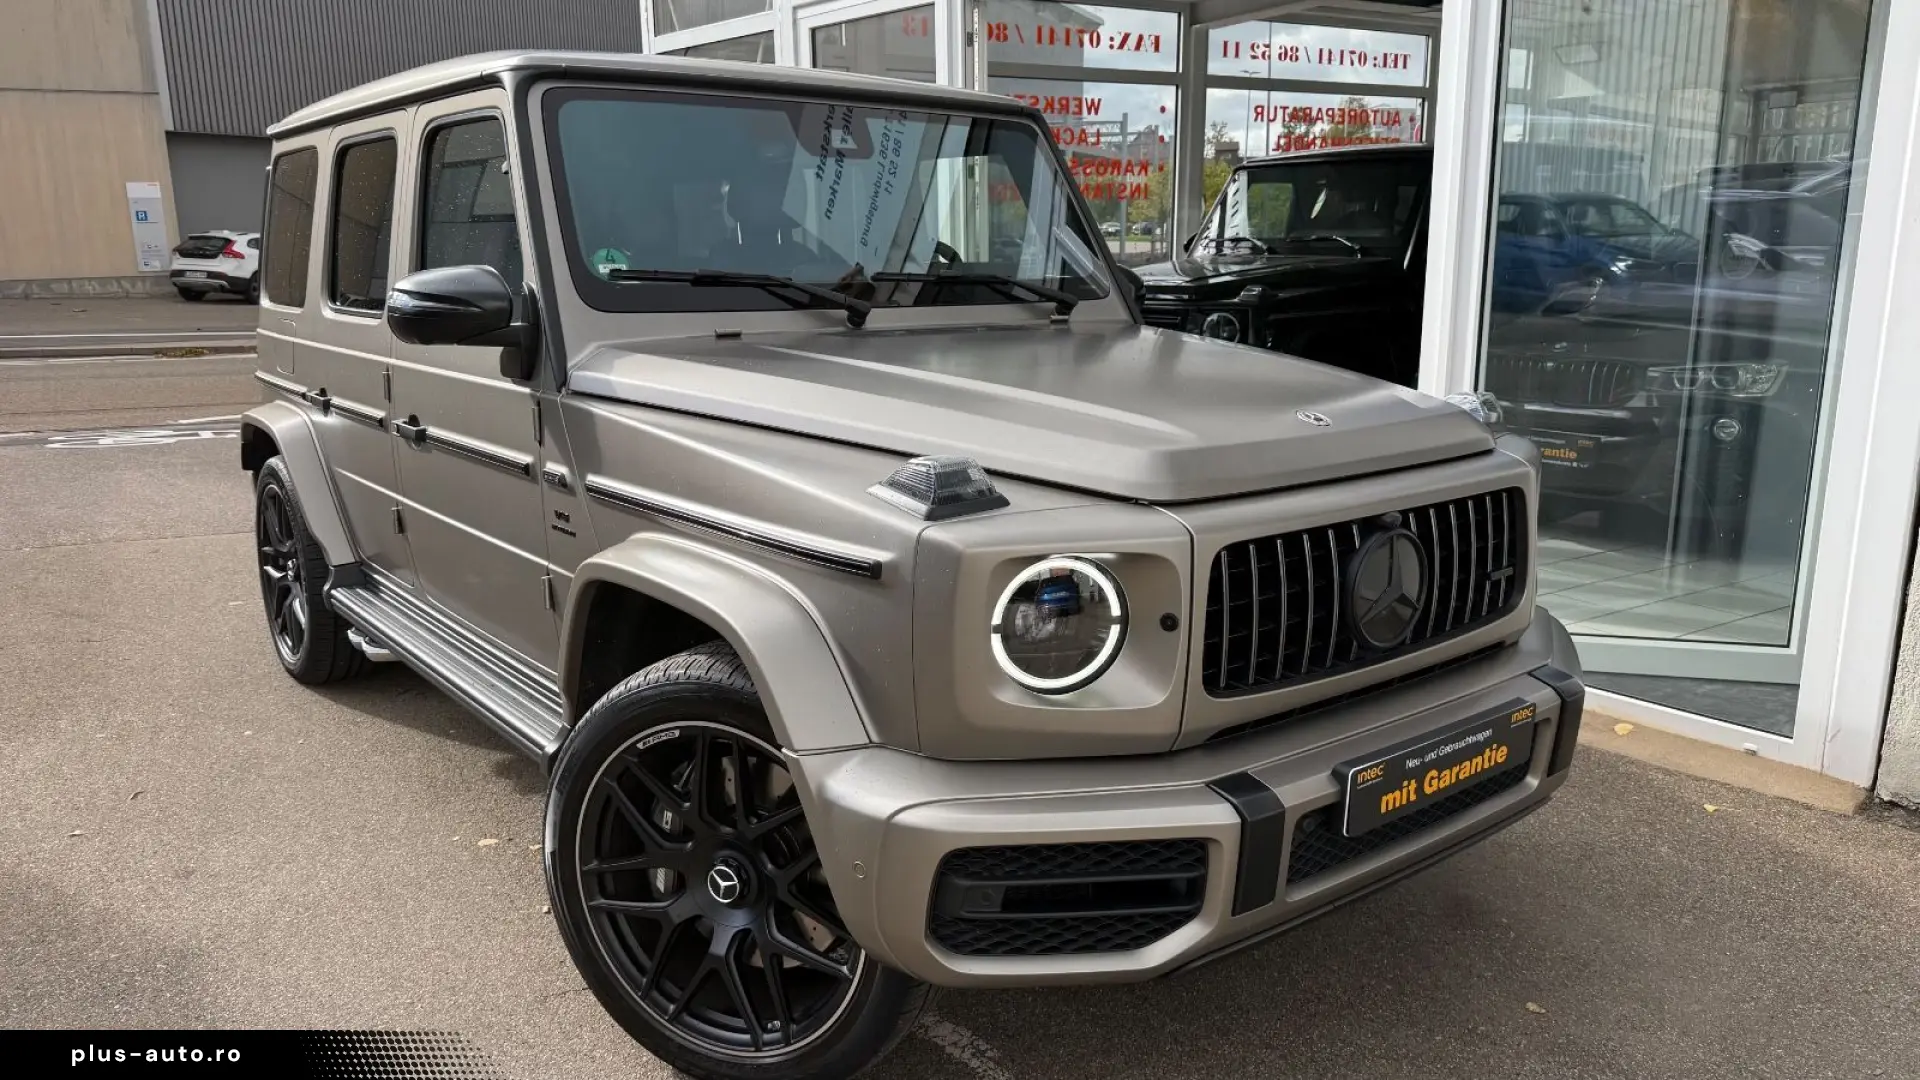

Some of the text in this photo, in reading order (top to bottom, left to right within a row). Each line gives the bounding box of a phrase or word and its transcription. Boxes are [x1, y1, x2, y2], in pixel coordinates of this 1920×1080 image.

[1511, 706, 1533, 723] intec
[1357, 764, 1385, 785] intec
[1380, 743, 1508, 814] mit Garantie
